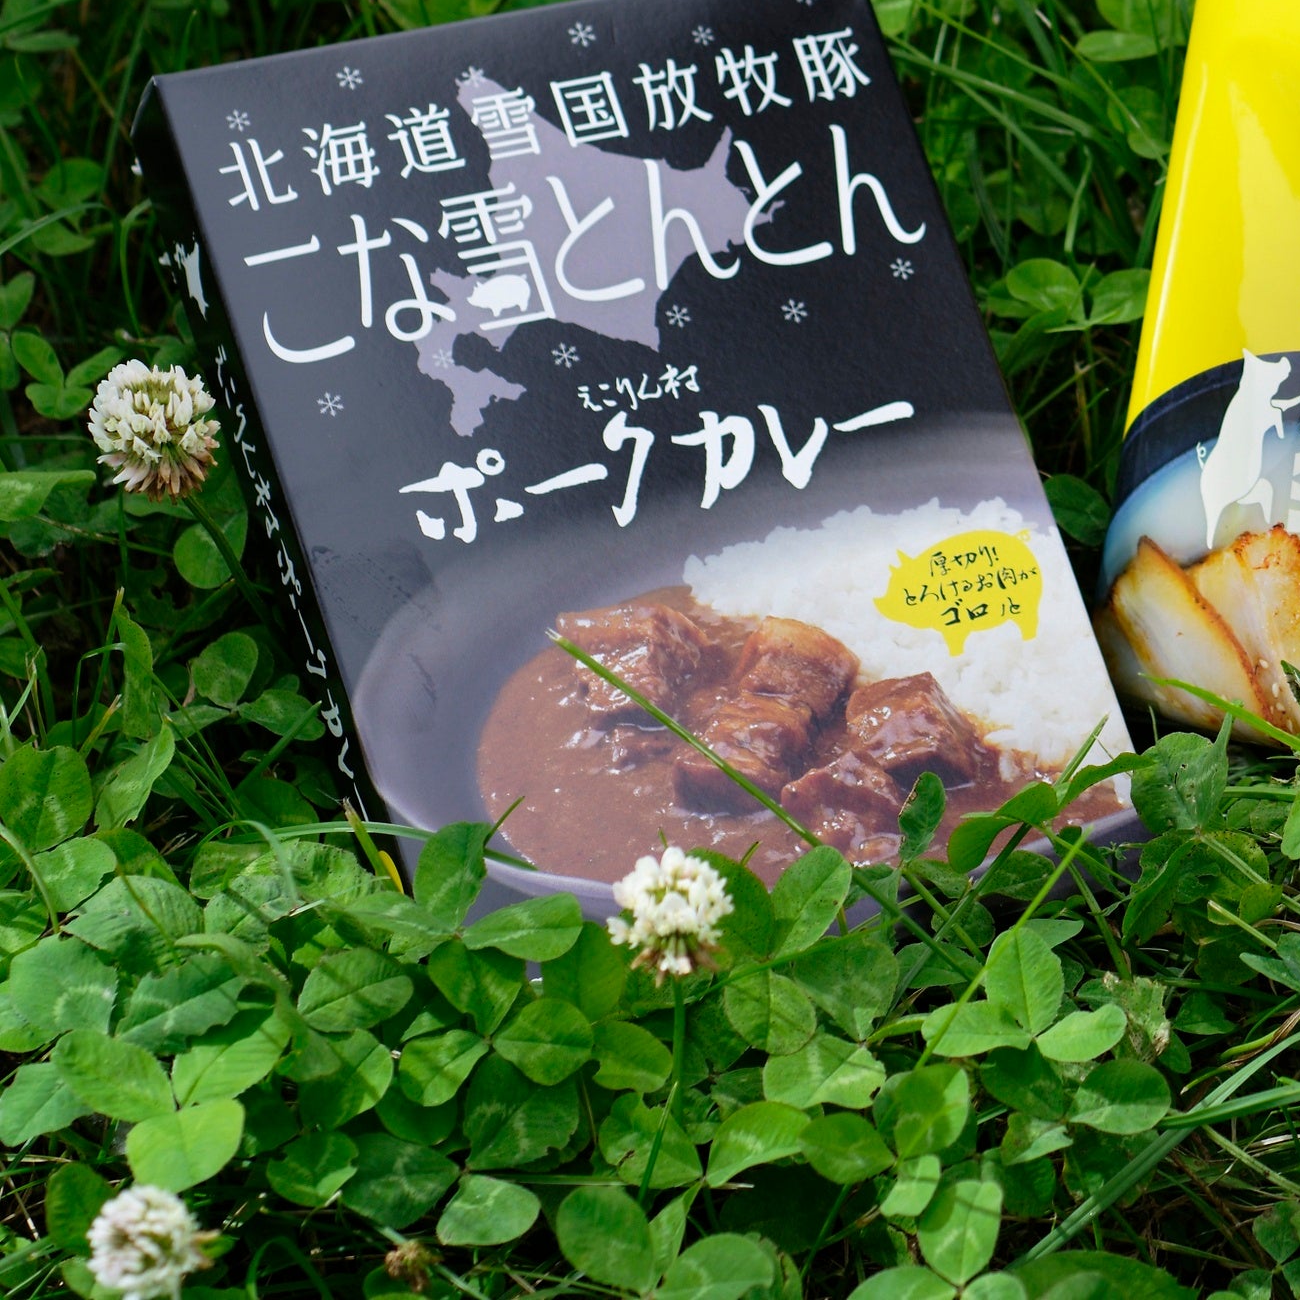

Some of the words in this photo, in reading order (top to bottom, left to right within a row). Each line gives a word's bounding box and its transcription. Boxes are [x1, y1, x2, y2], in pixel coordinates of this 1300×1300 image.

[218, 26, 872, 212] 北海道雪国放牧豚
[242, 124, 927, 365] こな雪とんとん
[398, 400, 915, 544] ポークカレー
